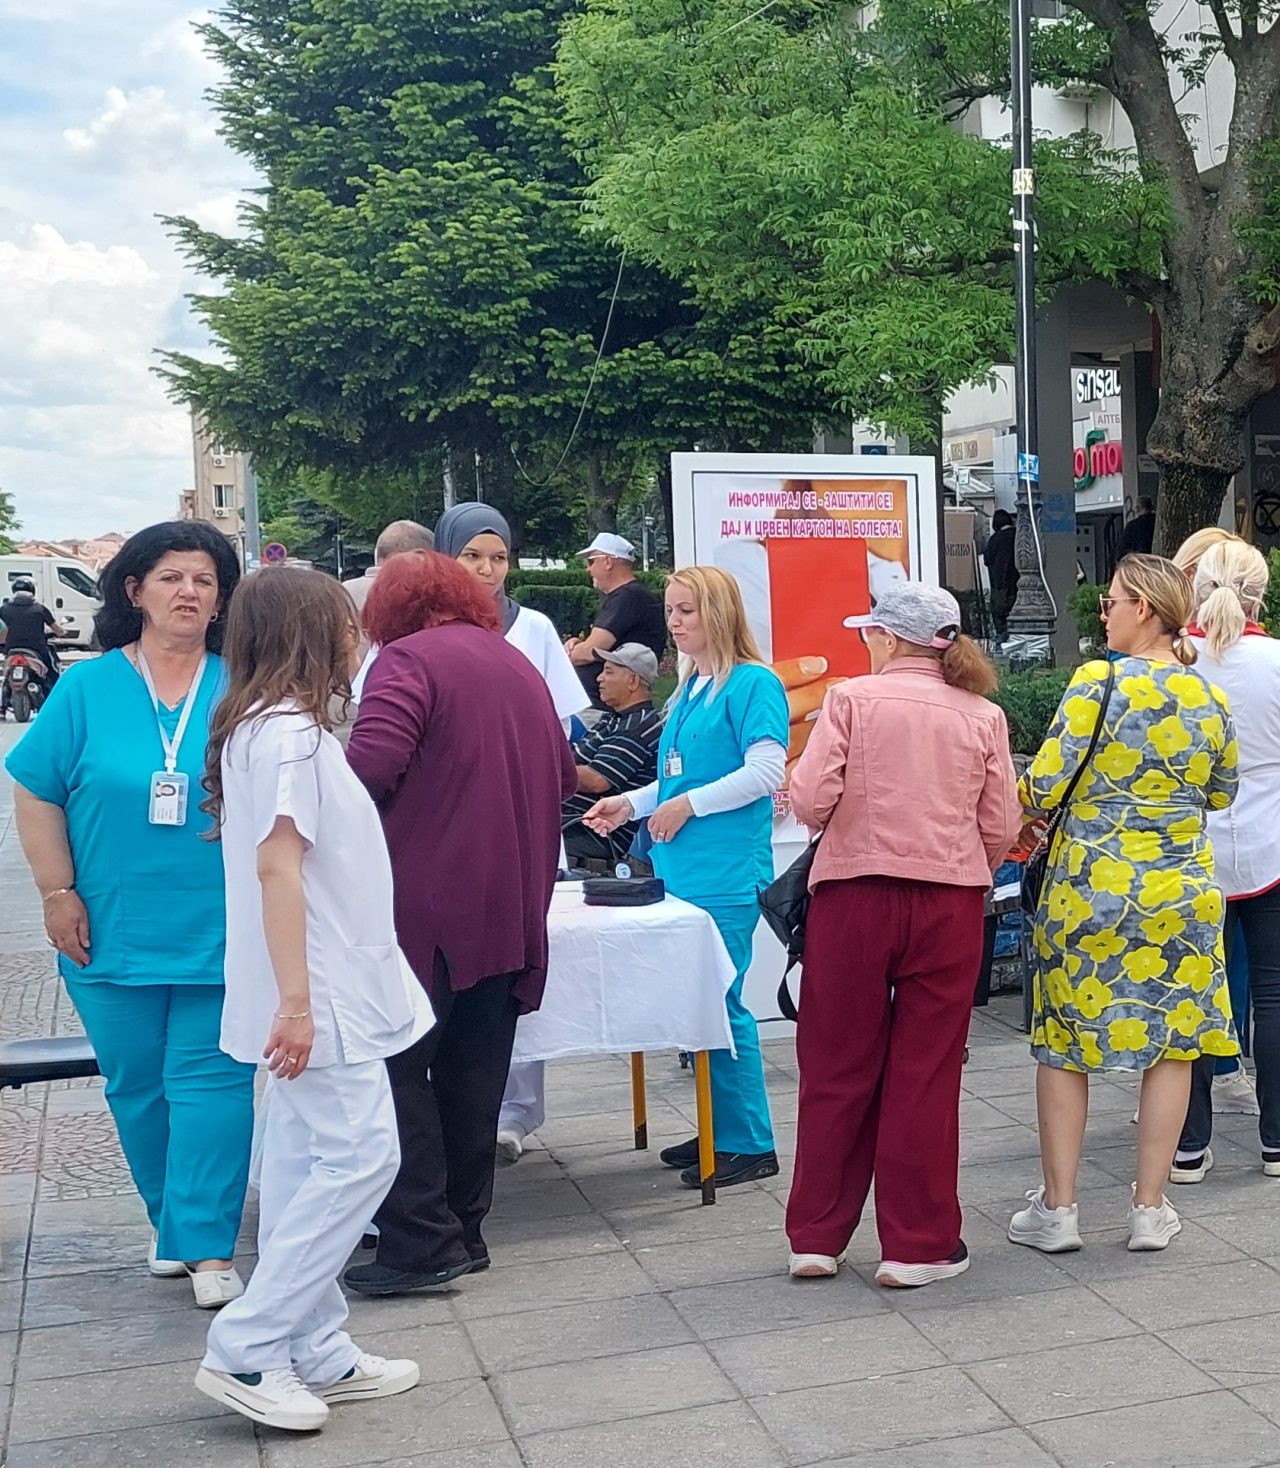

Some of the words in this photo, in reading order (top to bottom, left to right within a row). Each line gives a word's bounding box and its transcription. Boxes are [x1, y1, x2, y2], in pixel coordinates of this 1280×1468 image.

[728, 491, 801, 508] ИНФОРМИРАЈ
[803, 492, 817, 508] СЕ
[825, 493, 874, 509] ЗАШТИТИ
[877, 493, 893, 509] СЕ!
[721, 520, 741, 538] ДАЈ
[744, 520, 752, 536] И
[755, 520, 790, 538] ЦРВЕН
[792, 520, 833, 536] КАРТОН
[836, 520, 850, 536] НА
[853, 521, 902, 537] БОЛЕСТА!
